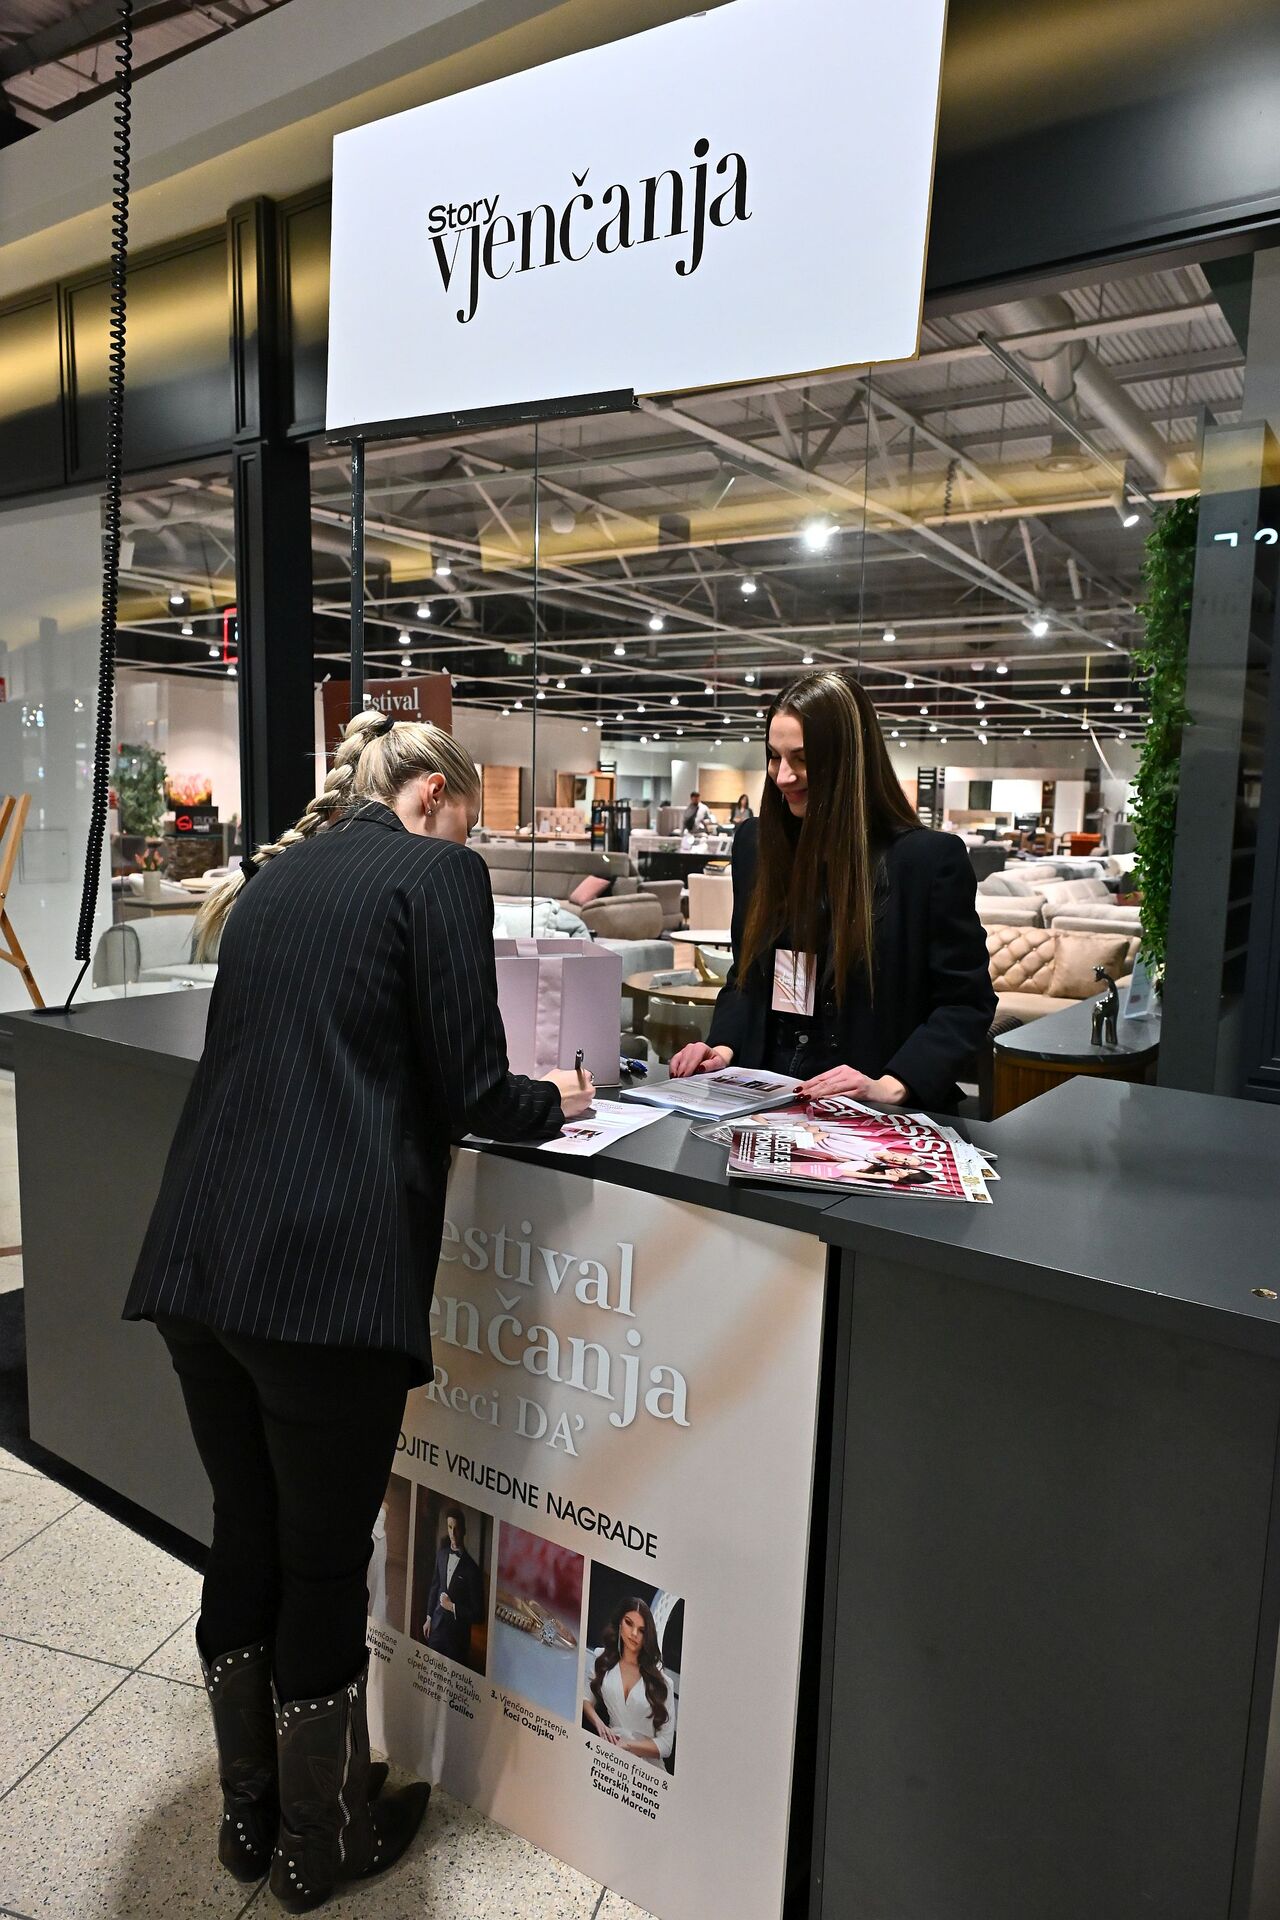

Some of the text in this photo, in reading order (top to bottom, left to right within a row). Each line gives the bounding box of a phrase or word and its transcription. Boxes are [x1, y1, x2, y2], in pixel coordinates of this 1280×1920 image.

[428, 194, 500, 234] Story
[428, 138, 753, 324] vjenčanja
[362, 686, 420, 711] estival
[909, 1140, 951, 1192] Story
[439, 1219, 637, 1318] estival
[430, 1287, 691, 1429] nčanja
[425, 1364, 501, 1429] Reci
[395, 1430, 658, 1559] OJITE VRIJEDNE NAGRADE
[366, 1634, 394, 1655] Nikolina
[373, 1647, 391, 1664] Store
[415, 1649, 422, 1659] 2.
[450, 1669, 474, 1688] prsluk,
[417, 1672, 436, 1687] leptir
[430, 1669, 453, 1688] remen,
[455, 1682, 482, 1703] košulja,
[412, 1681, 441, 1702] manžete
[448, 1700, 474, 1719] Galileo
[490, 1689, 569, 1739] 3. Vjenčano prstenje,
[503, 1707, 555, 1741] Koci Ozaljska
[584, 1740, 669, 1791] 4. Svečana frizura &
[593, 1757, 615, 1774] make
[632, 1776, 659, 1798] Lanac
[590, 1766, 660, 1810] frizerskih salona
[592, 1778, 657, 1820] Studio Marcela
